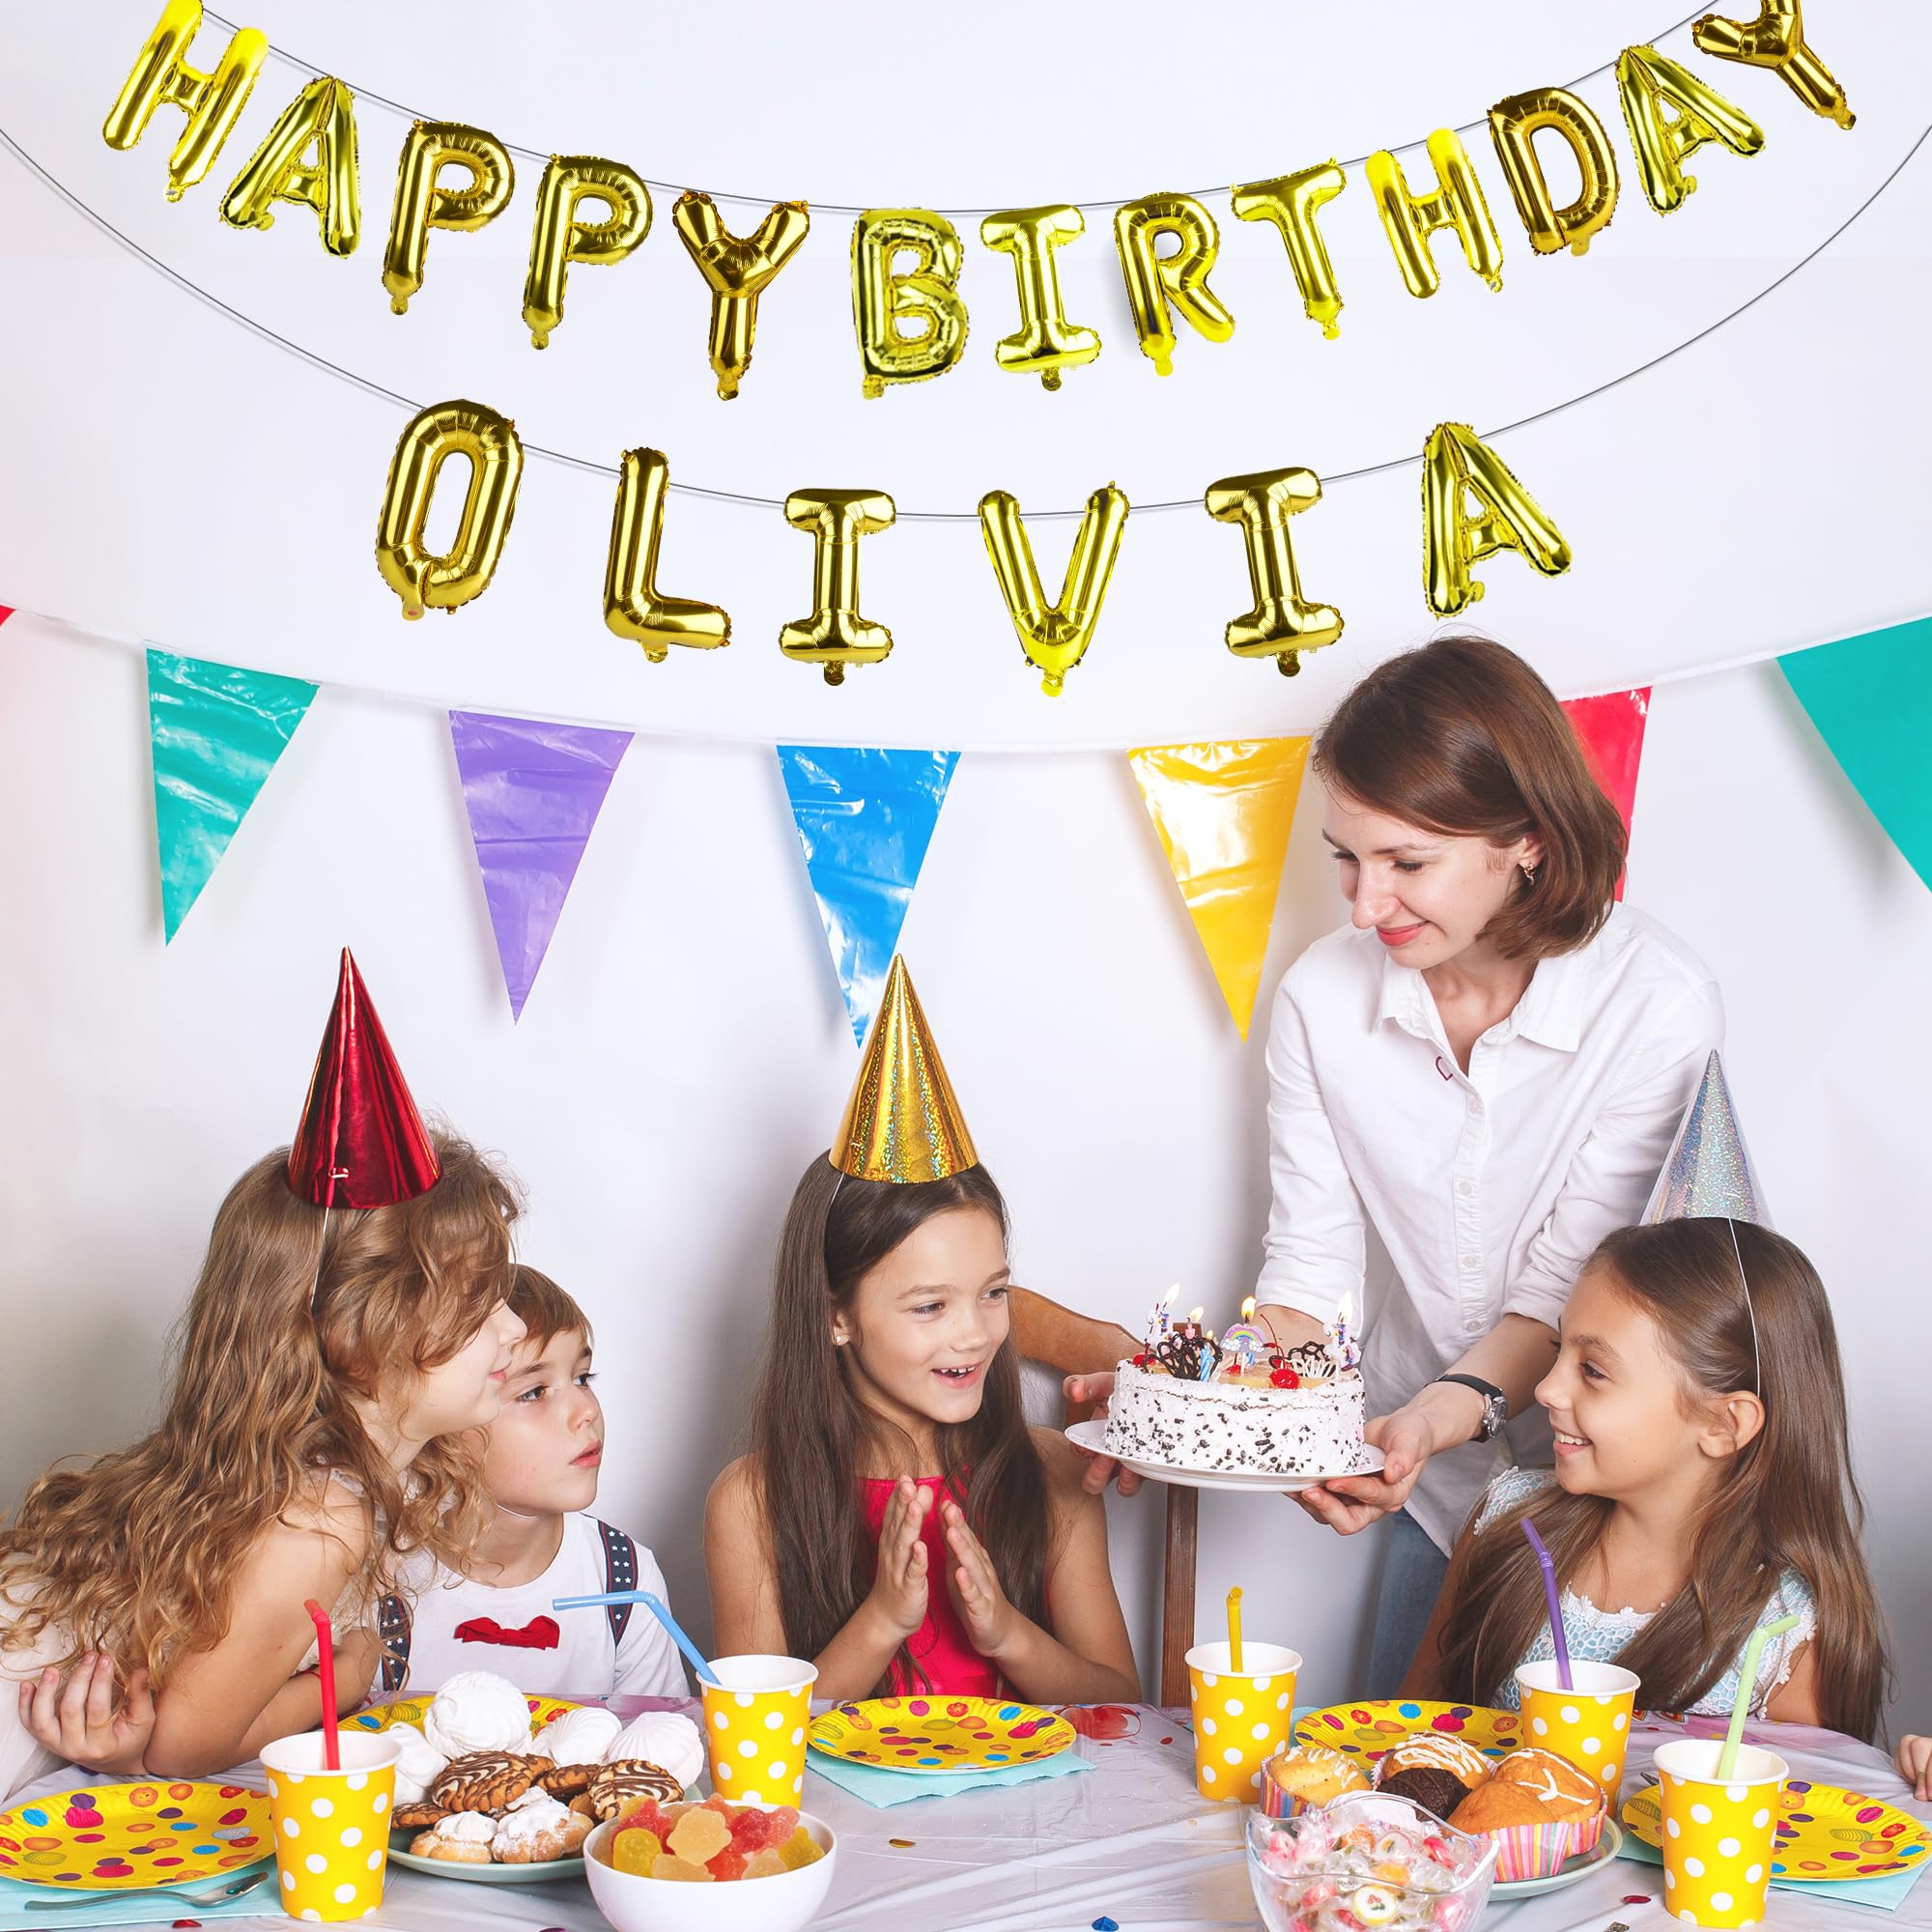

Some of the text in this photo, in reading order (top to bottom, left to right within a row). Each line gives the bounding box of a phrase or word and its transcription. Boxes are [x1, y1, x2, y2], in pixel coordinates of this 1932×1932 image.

[102, 0, 1856, 401] HAPPY BIRTHDAY
[375, 399, 1573, 697] OLIVIA
